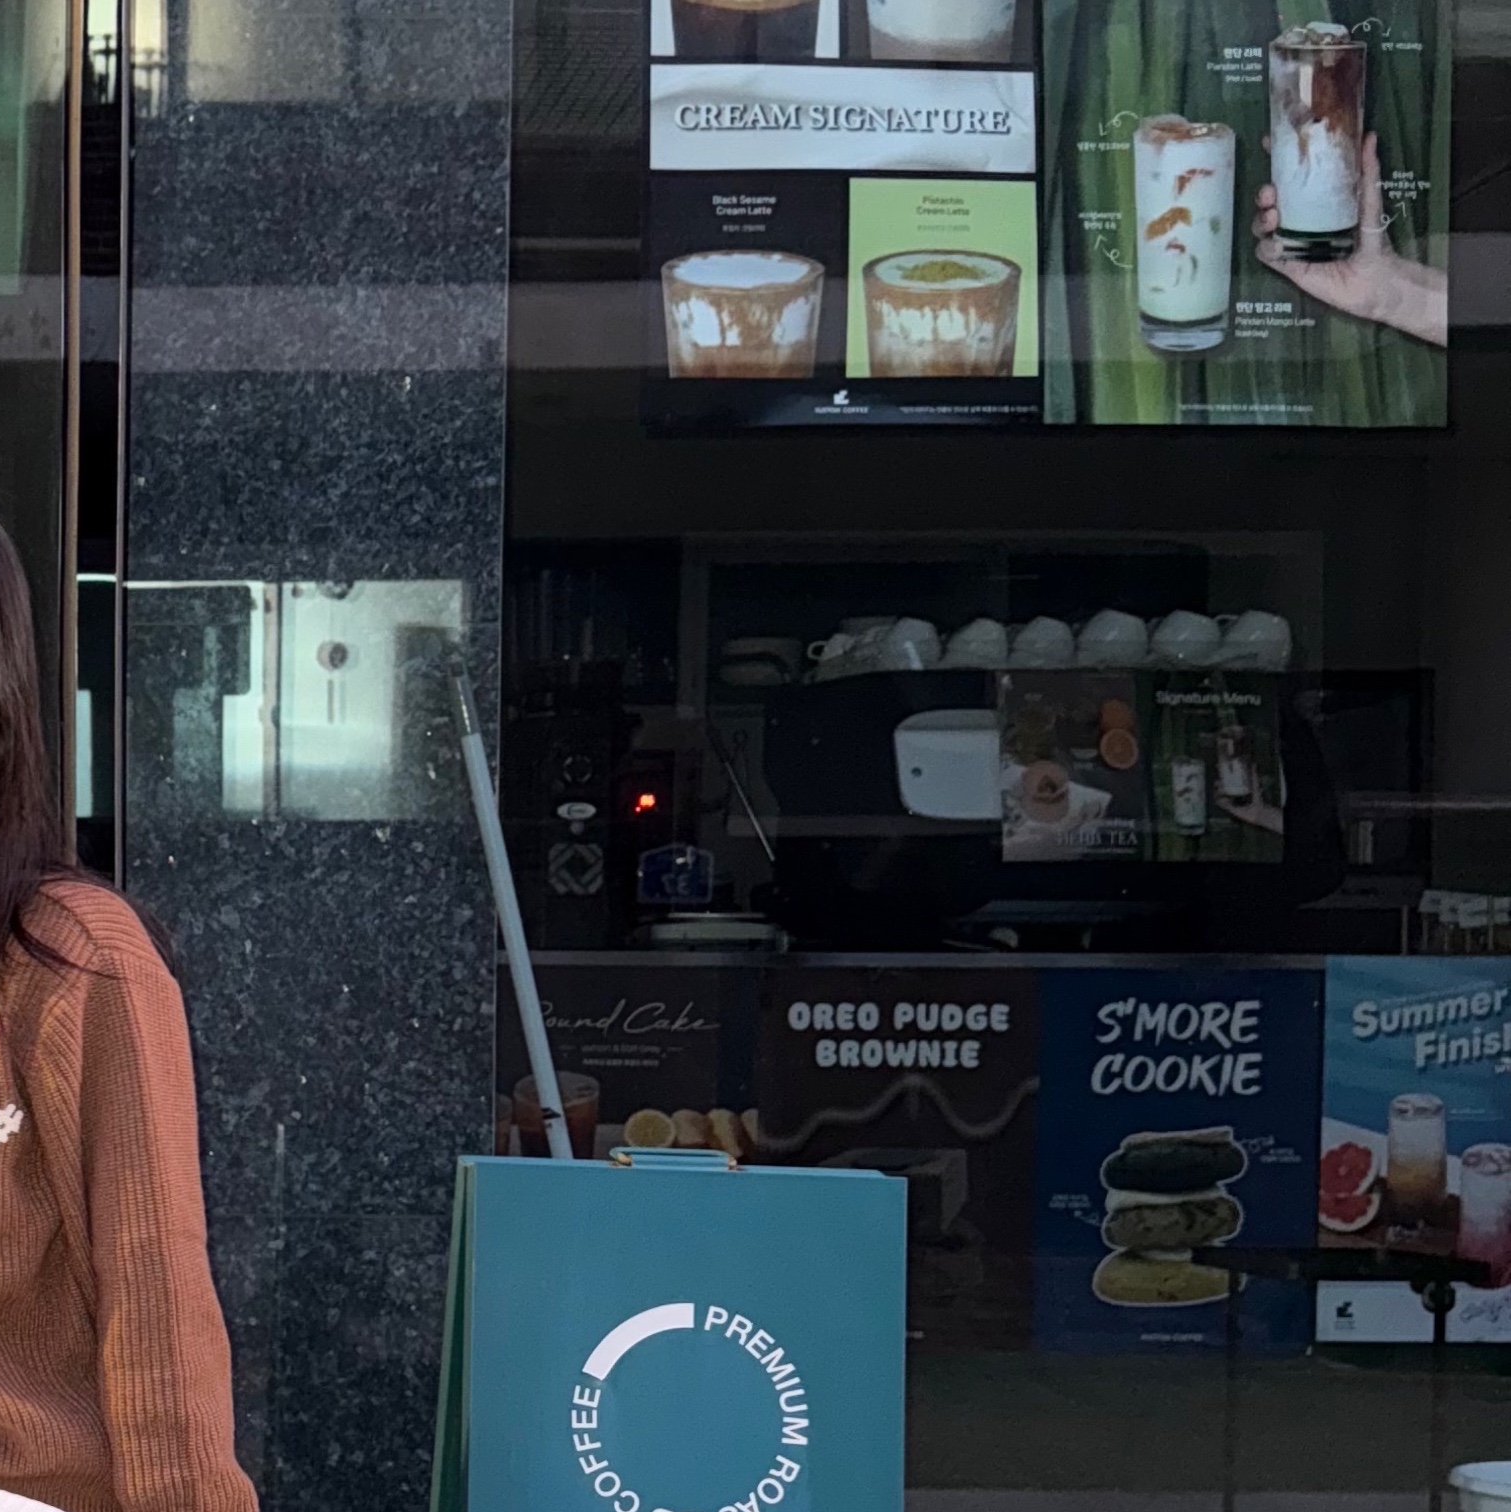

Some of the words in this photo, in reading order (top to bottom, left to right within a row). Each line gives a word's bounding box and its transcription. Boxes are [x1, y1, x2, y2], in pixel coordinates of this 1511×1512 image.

[674, 103, 802, 131] CREAM
[807, 105, 1012, 135] SIGNATURE
[712, 195, 738, 205] Black
[739, 195, 777, 205] Sesame
[716, 206, 746, 216] Cream
[747, 206, 772, 216] Latte
[1155, 690, 1221, 706] Signature
[1223, 692, 1262, 706] Menu
[1108, 829, 1139, 846] TEA
[623, 1001, 721, 1034] Cake
[788, 1001, 880, 1031] OREO
[893, 1002, 1011, 1032] PUDGE
[1095, 997, 1262, 1049] S'MORE
[1352, 988, 1509, 1038] Summer
[815, 1038, 981, 1068] BROWNIE
[1091, 1053, 1263, 1097] COOKIE
[703, 1305, 810, 1446] PREMIUM
